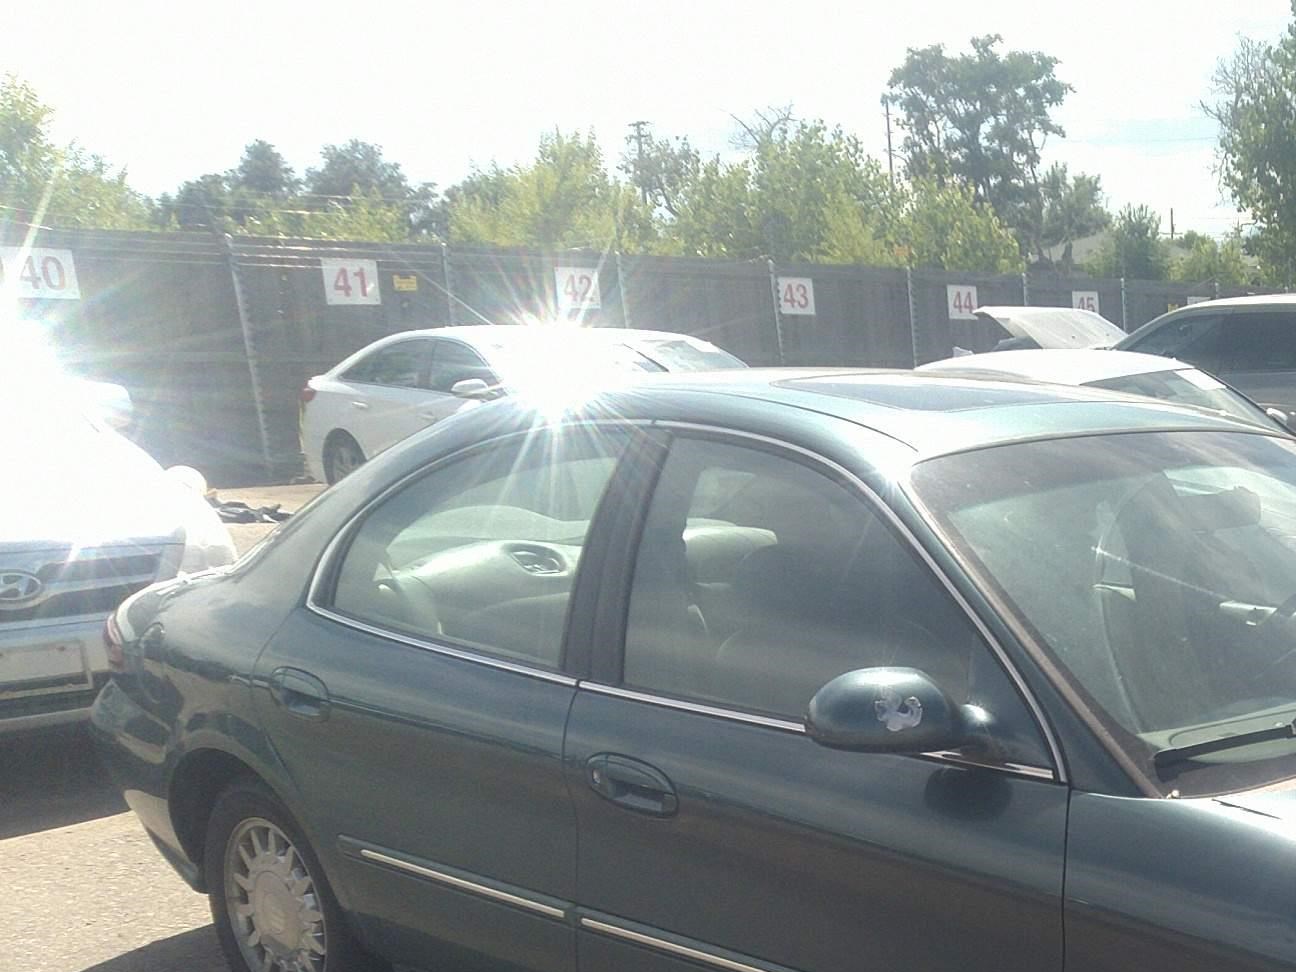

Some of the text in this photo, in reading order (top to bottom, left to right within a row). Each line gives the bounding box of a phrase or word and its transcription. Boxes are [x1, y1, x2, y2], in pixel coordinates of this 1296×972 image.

[20, 255, 65, 290] 40
[334, 267, 368, 297] 41
[564, 274, 594, 302] 42
[783, 283, 809, 309] 43
[953, 291, 974, 314] 44
